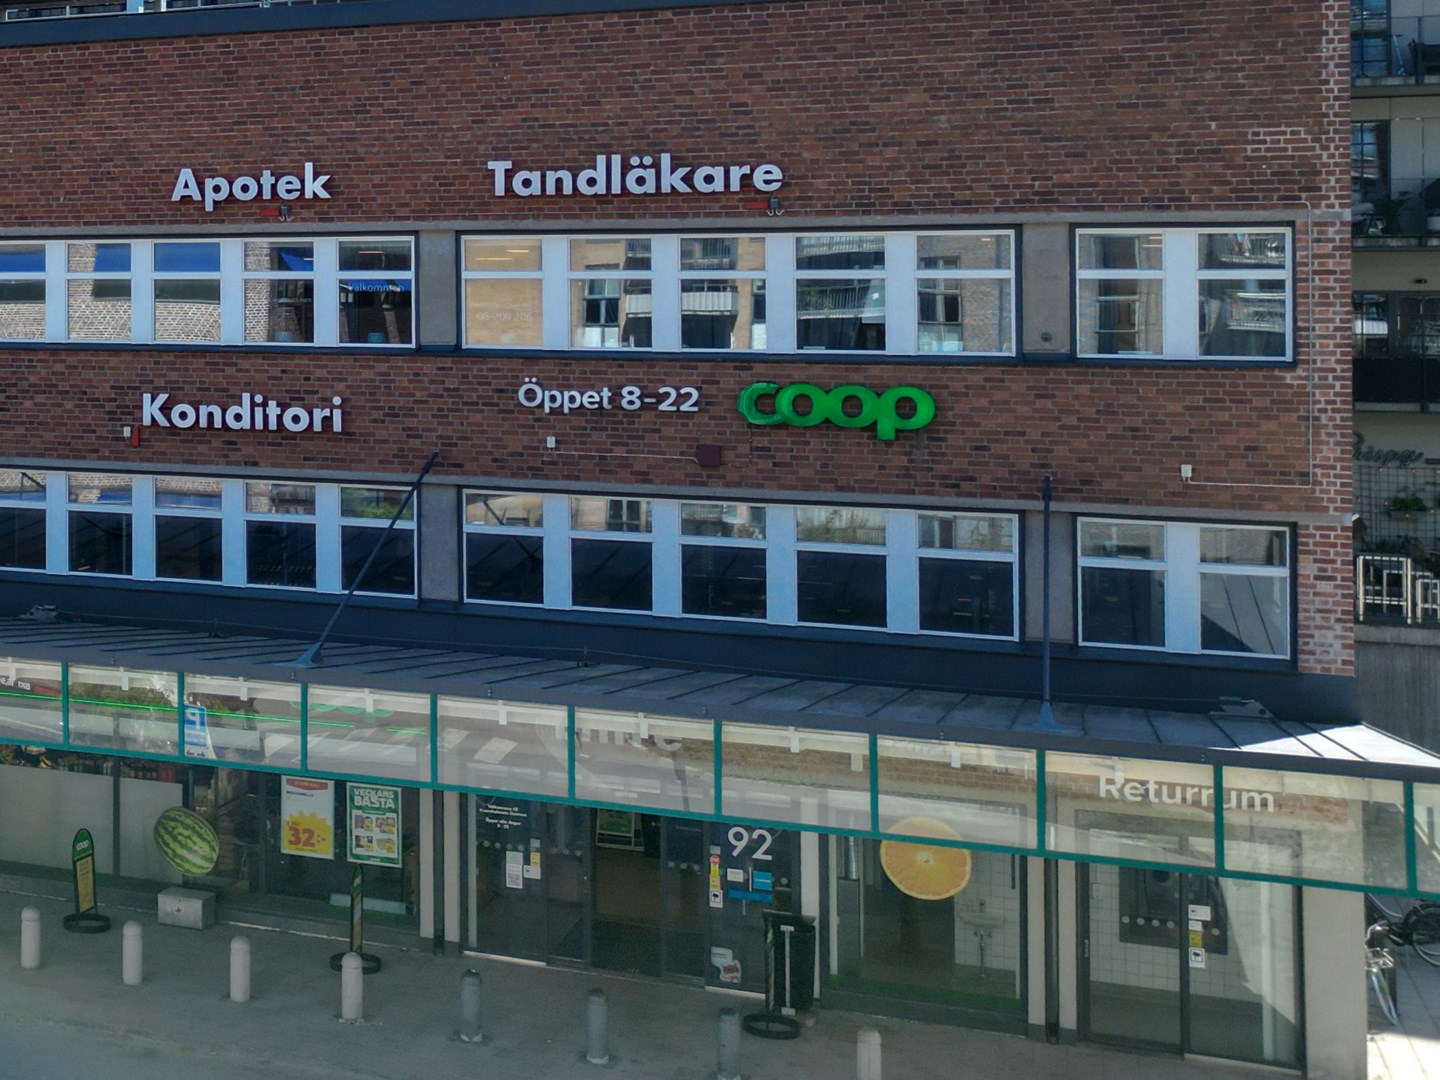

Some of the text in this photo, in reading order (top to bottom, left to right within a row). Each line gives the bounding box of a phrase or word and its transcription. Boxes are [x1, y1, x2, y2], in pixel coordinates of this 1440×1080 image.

[171, 162, 332, 212] Apotek
[487, 153, 784, 196] Tandläkare
[142, 392, 343, 433] Konditori
[518, 377, 700, 414] Öppet 8-22
[737, 382, 936, 441] coop
[353, 788, 395, 799] VECKANS
[1099, 775, 1274, 812] Returrum
[728, 826, 773, 861] 92
